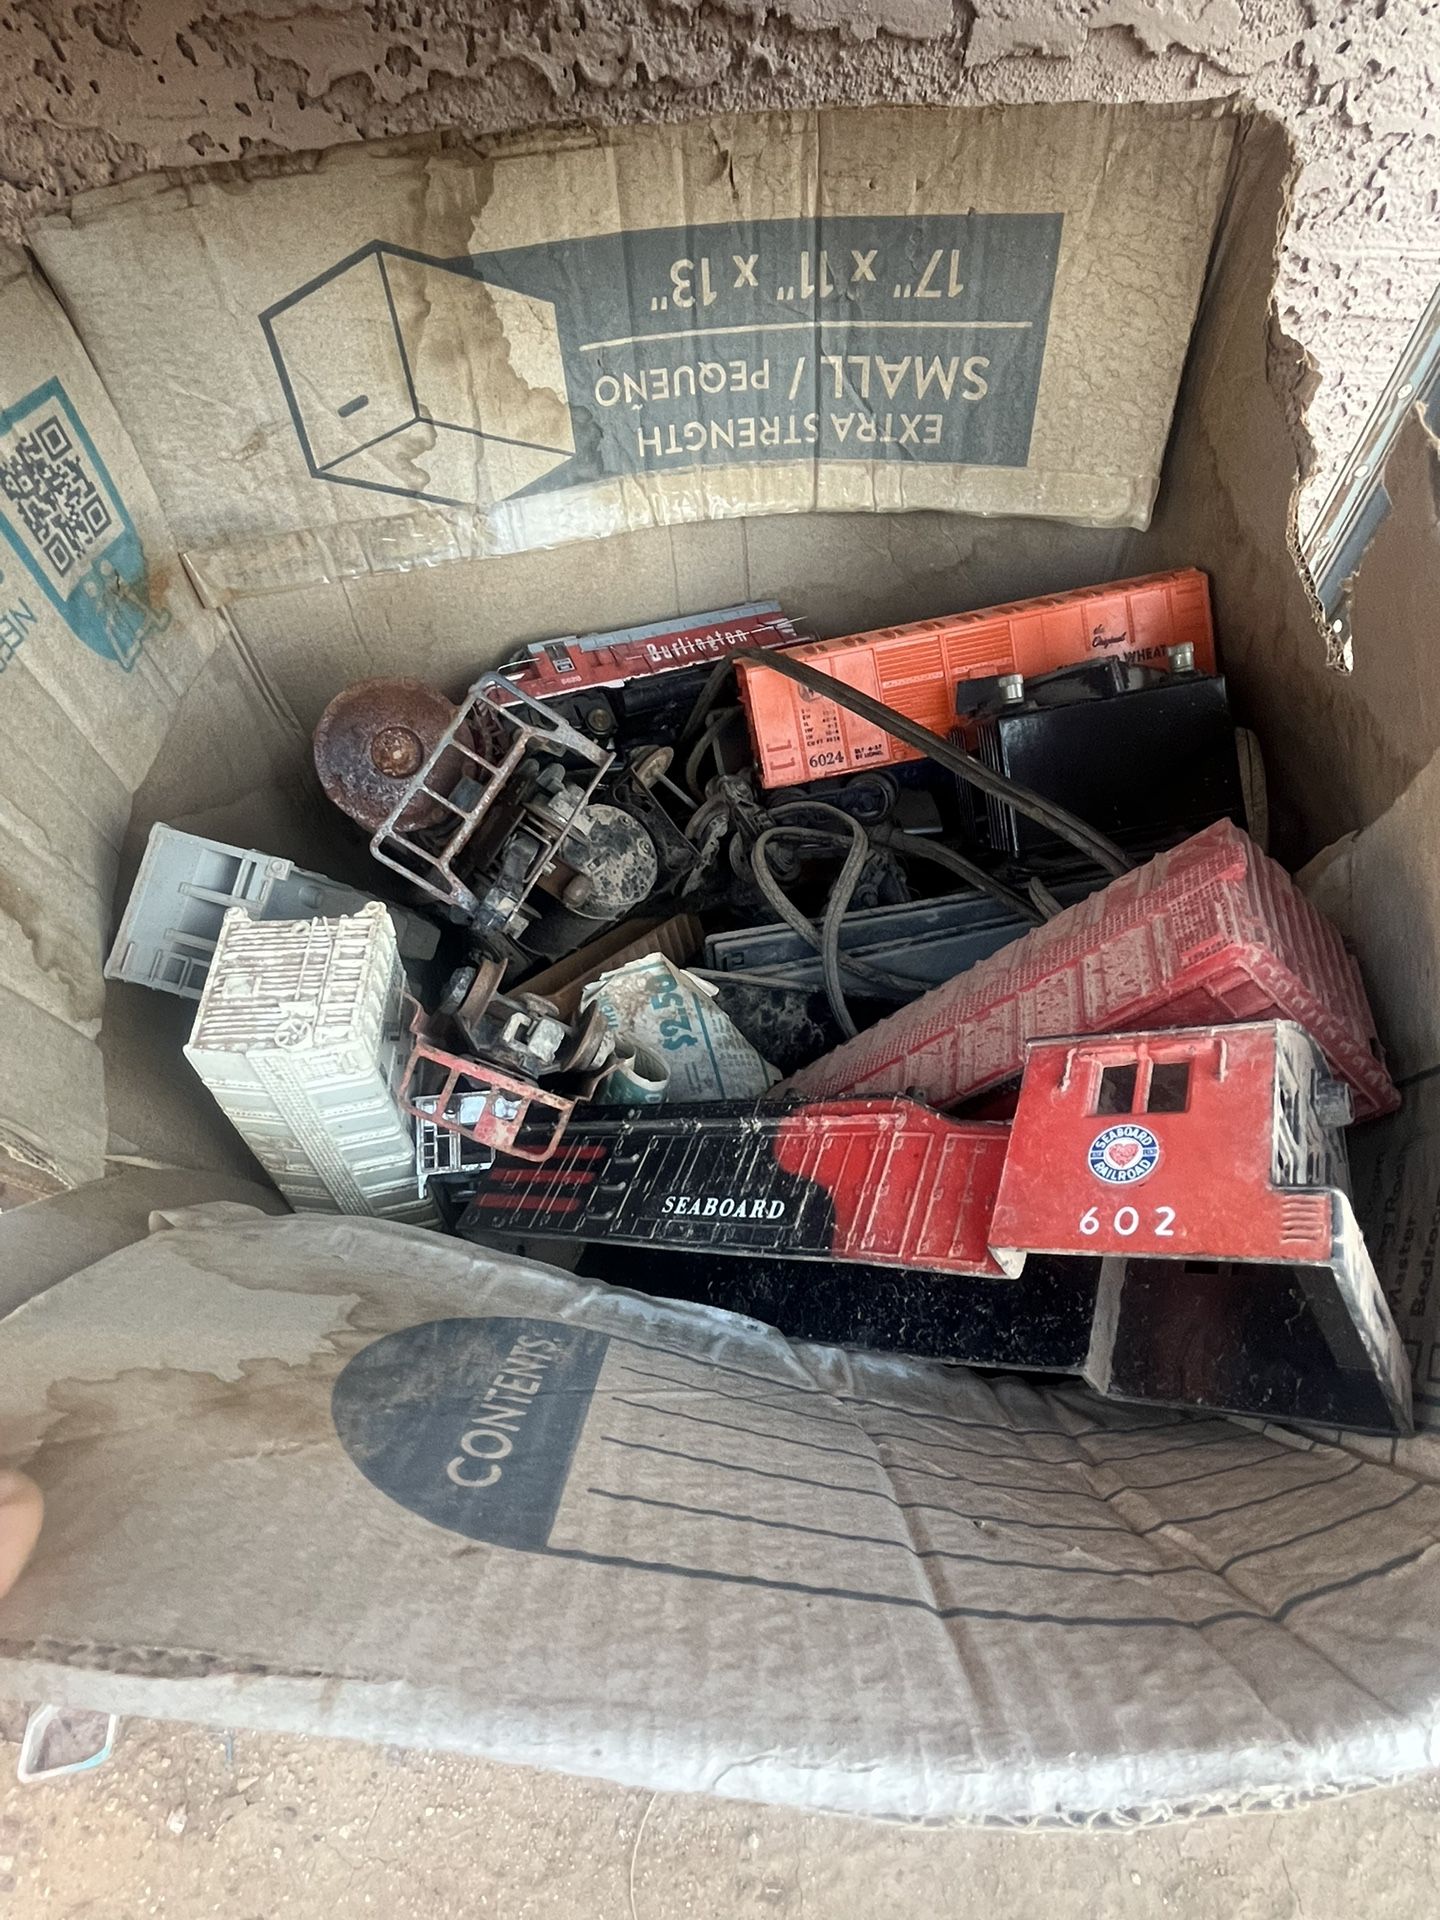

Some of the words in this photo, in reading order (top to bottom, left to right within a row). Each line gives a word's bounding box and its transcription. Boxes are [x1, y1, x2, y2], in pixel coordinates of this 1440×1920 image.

[733, 254, 759, 288] x
[776, 250, 834, 300] 11"
[851, 249, 879, 282] x
[894, 248, 965, 298] 17"
[650, 256, 717, 310] 13"
[594, 358, 770, 412] PEQUEÑO
[789, 356, 805, 399] /
[819, 355, 990, 401] SMALL
[637, 412, 818, 458] STRENGTH
[830, 411, 944, 444] EXTRA
[646, 629, 749, 662] Burlington
[1124, 645, 1167, 663] WHEAT
[809, 750, 845, 768] 6024
[647, 974, 698, 1051] $2.50
[1095, 1126, 1153, 1149] SEABOARD
[1094, 1160, 1151, 1181] RAILROAD
[662, 1196, 785, 1219] SEABOARD
[1079, 1205, 1176, 1236] 602
